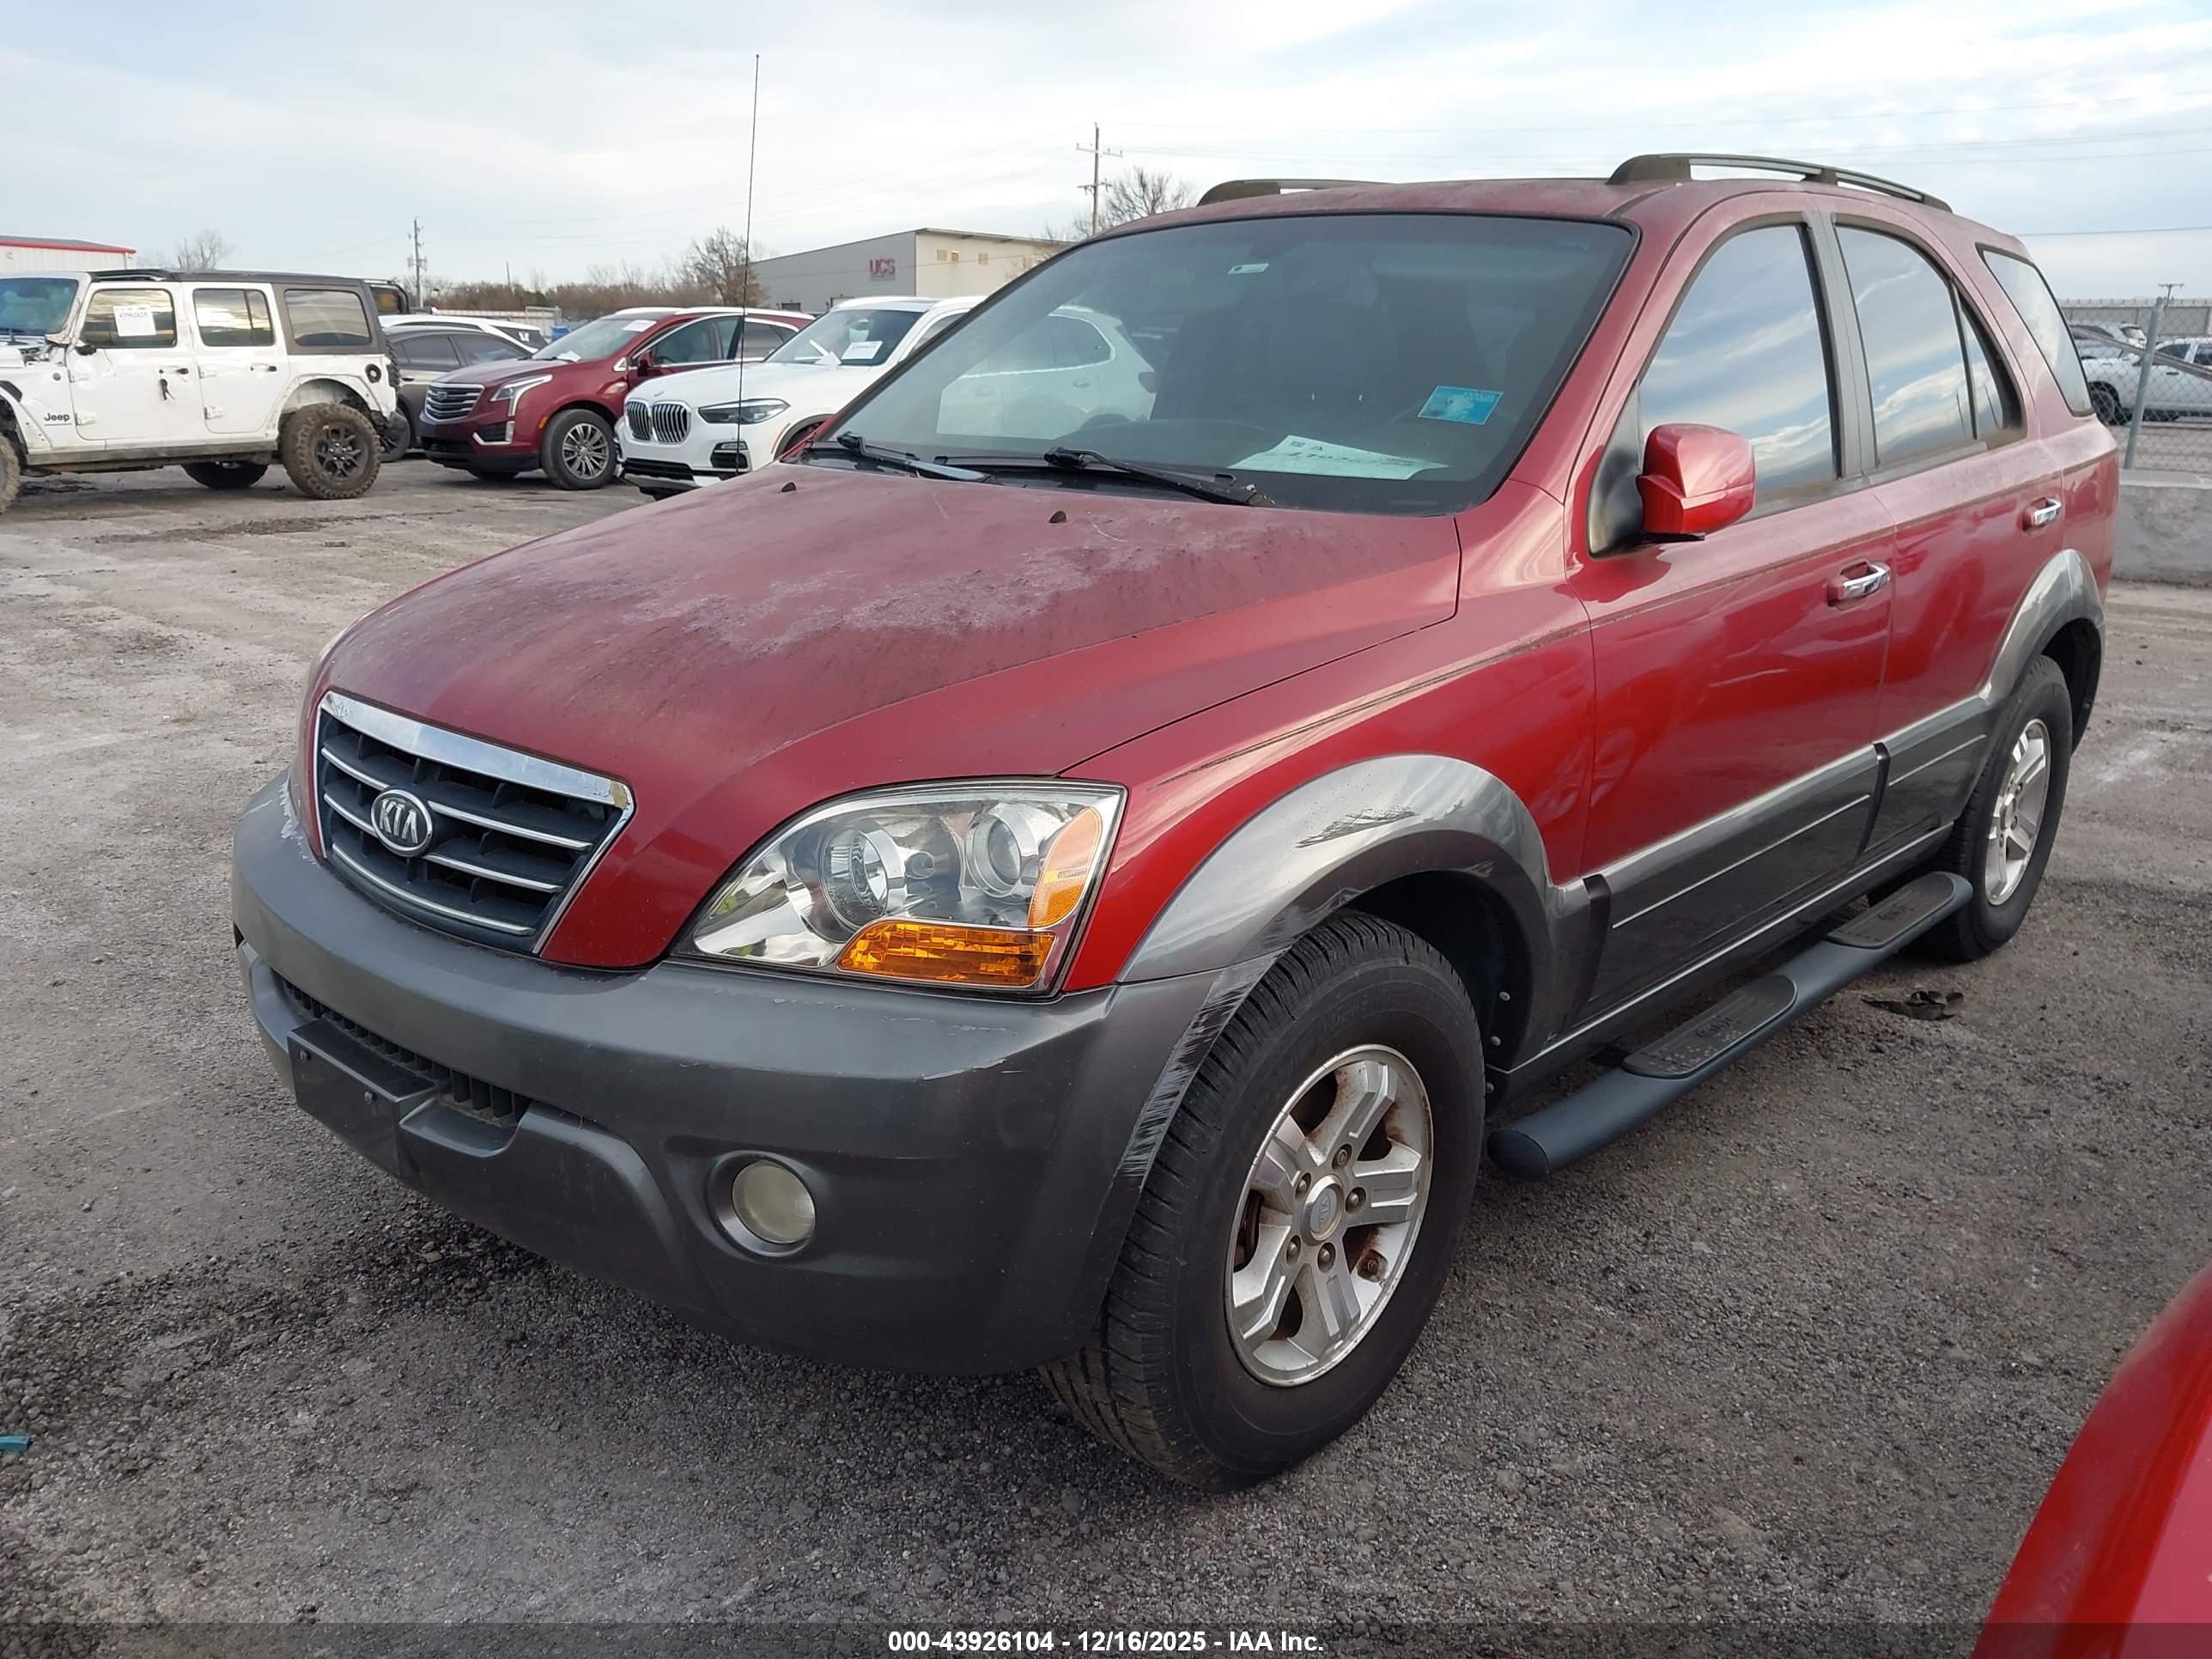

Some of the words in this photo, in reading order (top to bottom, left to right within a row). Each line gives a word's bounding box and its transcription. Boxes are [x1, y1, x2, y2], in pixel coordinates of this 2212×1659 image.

[870, 258, 896, 275] UCS
[44, 412, 70, 422] Jeep
[379, 799, 419, 844] KIA
